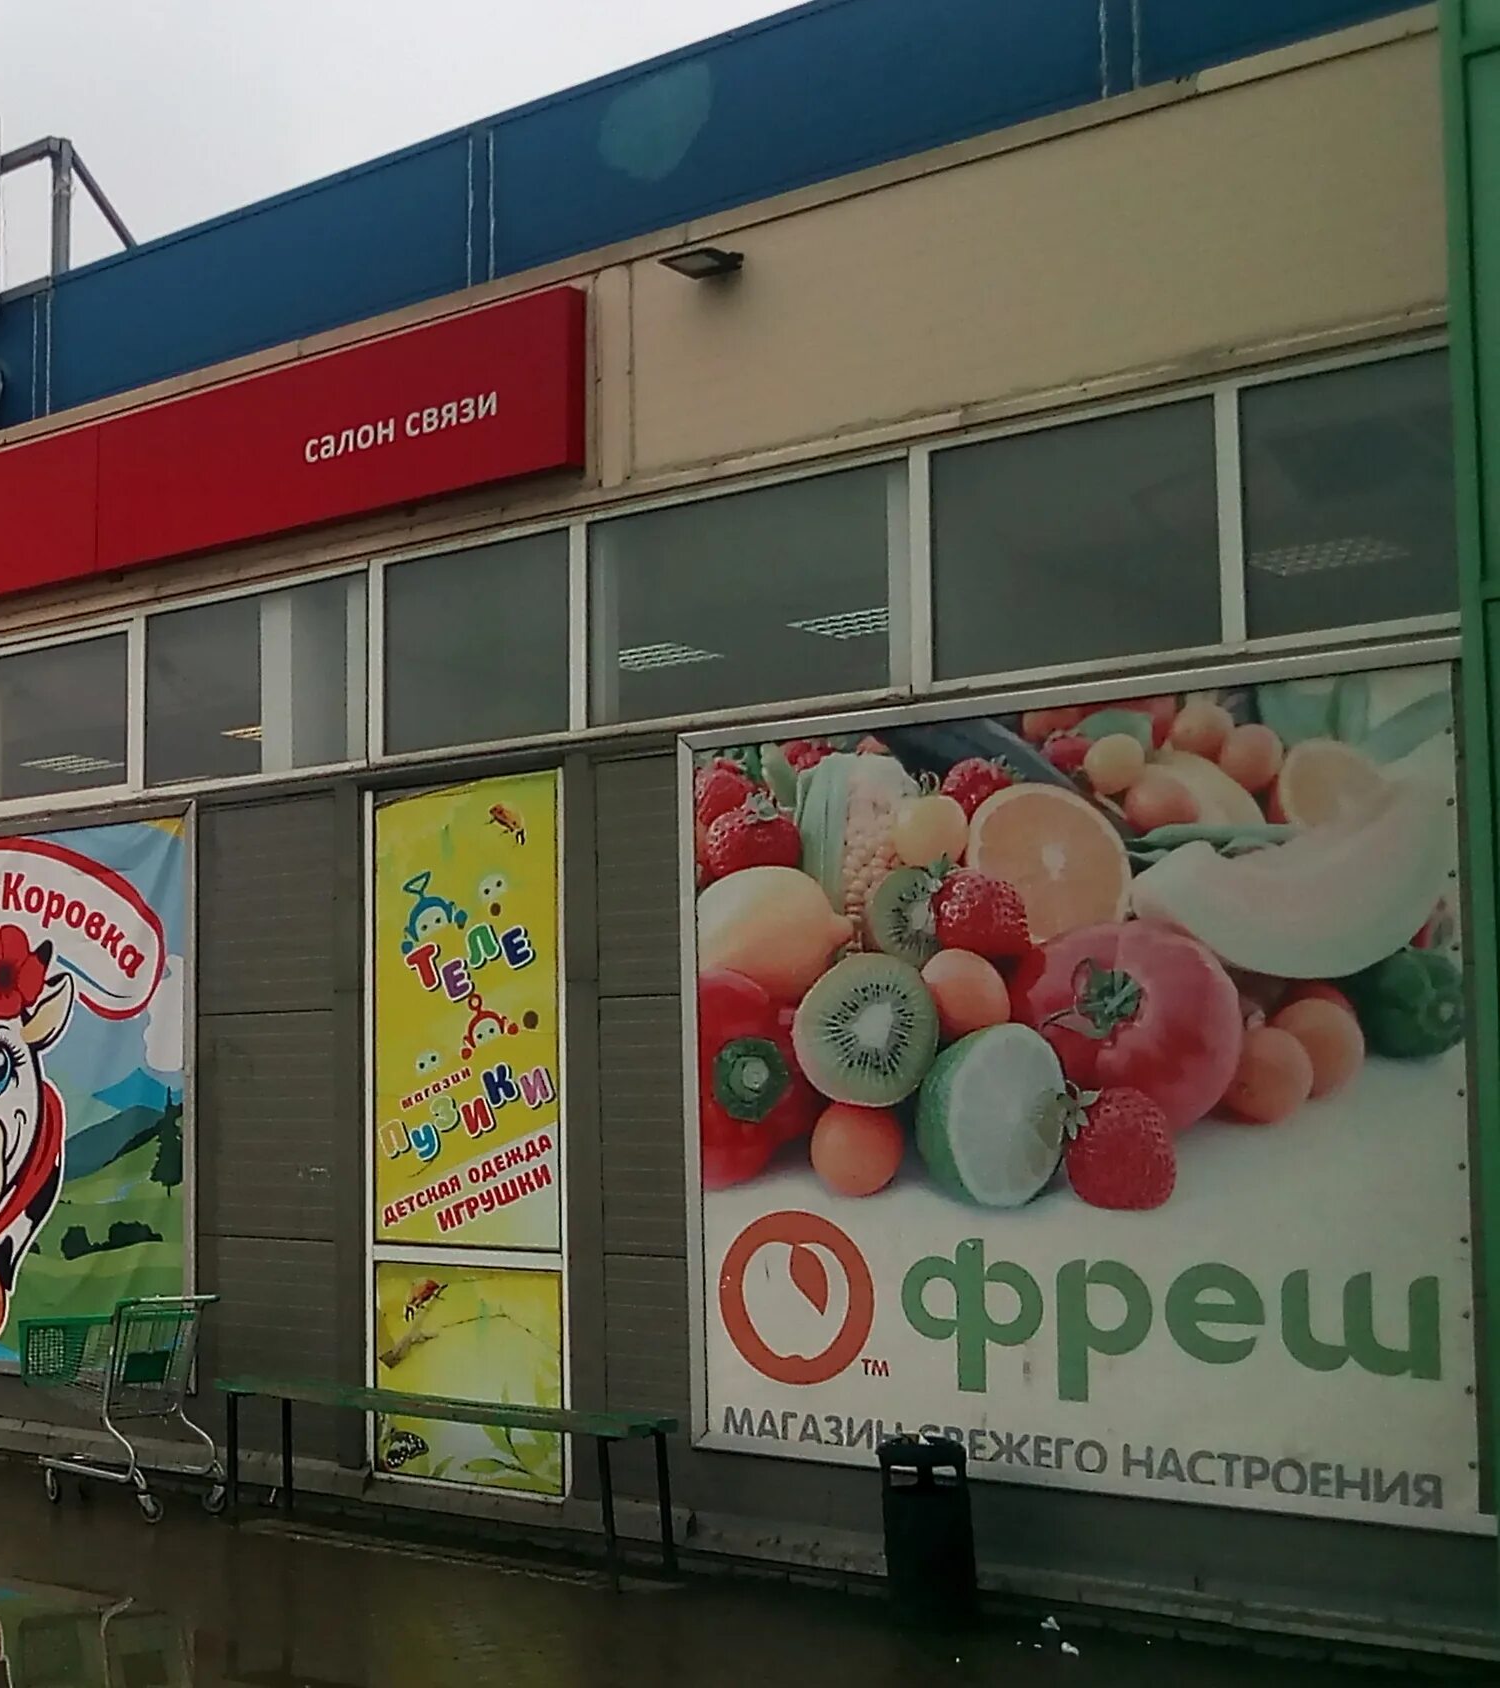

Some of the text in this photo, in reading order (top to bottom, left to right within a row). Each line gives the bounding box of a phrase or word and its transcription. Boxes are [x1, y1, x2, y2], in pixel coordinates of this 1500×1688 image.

[304, 390, 498, 464] салон связи
[1, 871, 146, 979] Коровка
[404, 922, 536, 1002] ТЕЛЕ
[401, 1067, 472, 1110] магазин
[382, 1134, 553, 1228] ДЕТСКАЯ ОДЕЖДА
[436, 1163, 553, 1232] ИГРУШКИ
[901, 1237, 1443, 1402] фреш
[861, 1358, 889, 1378] TM
[1123, 1444, 1444, 1511] НАСТРОЕНИЯ
